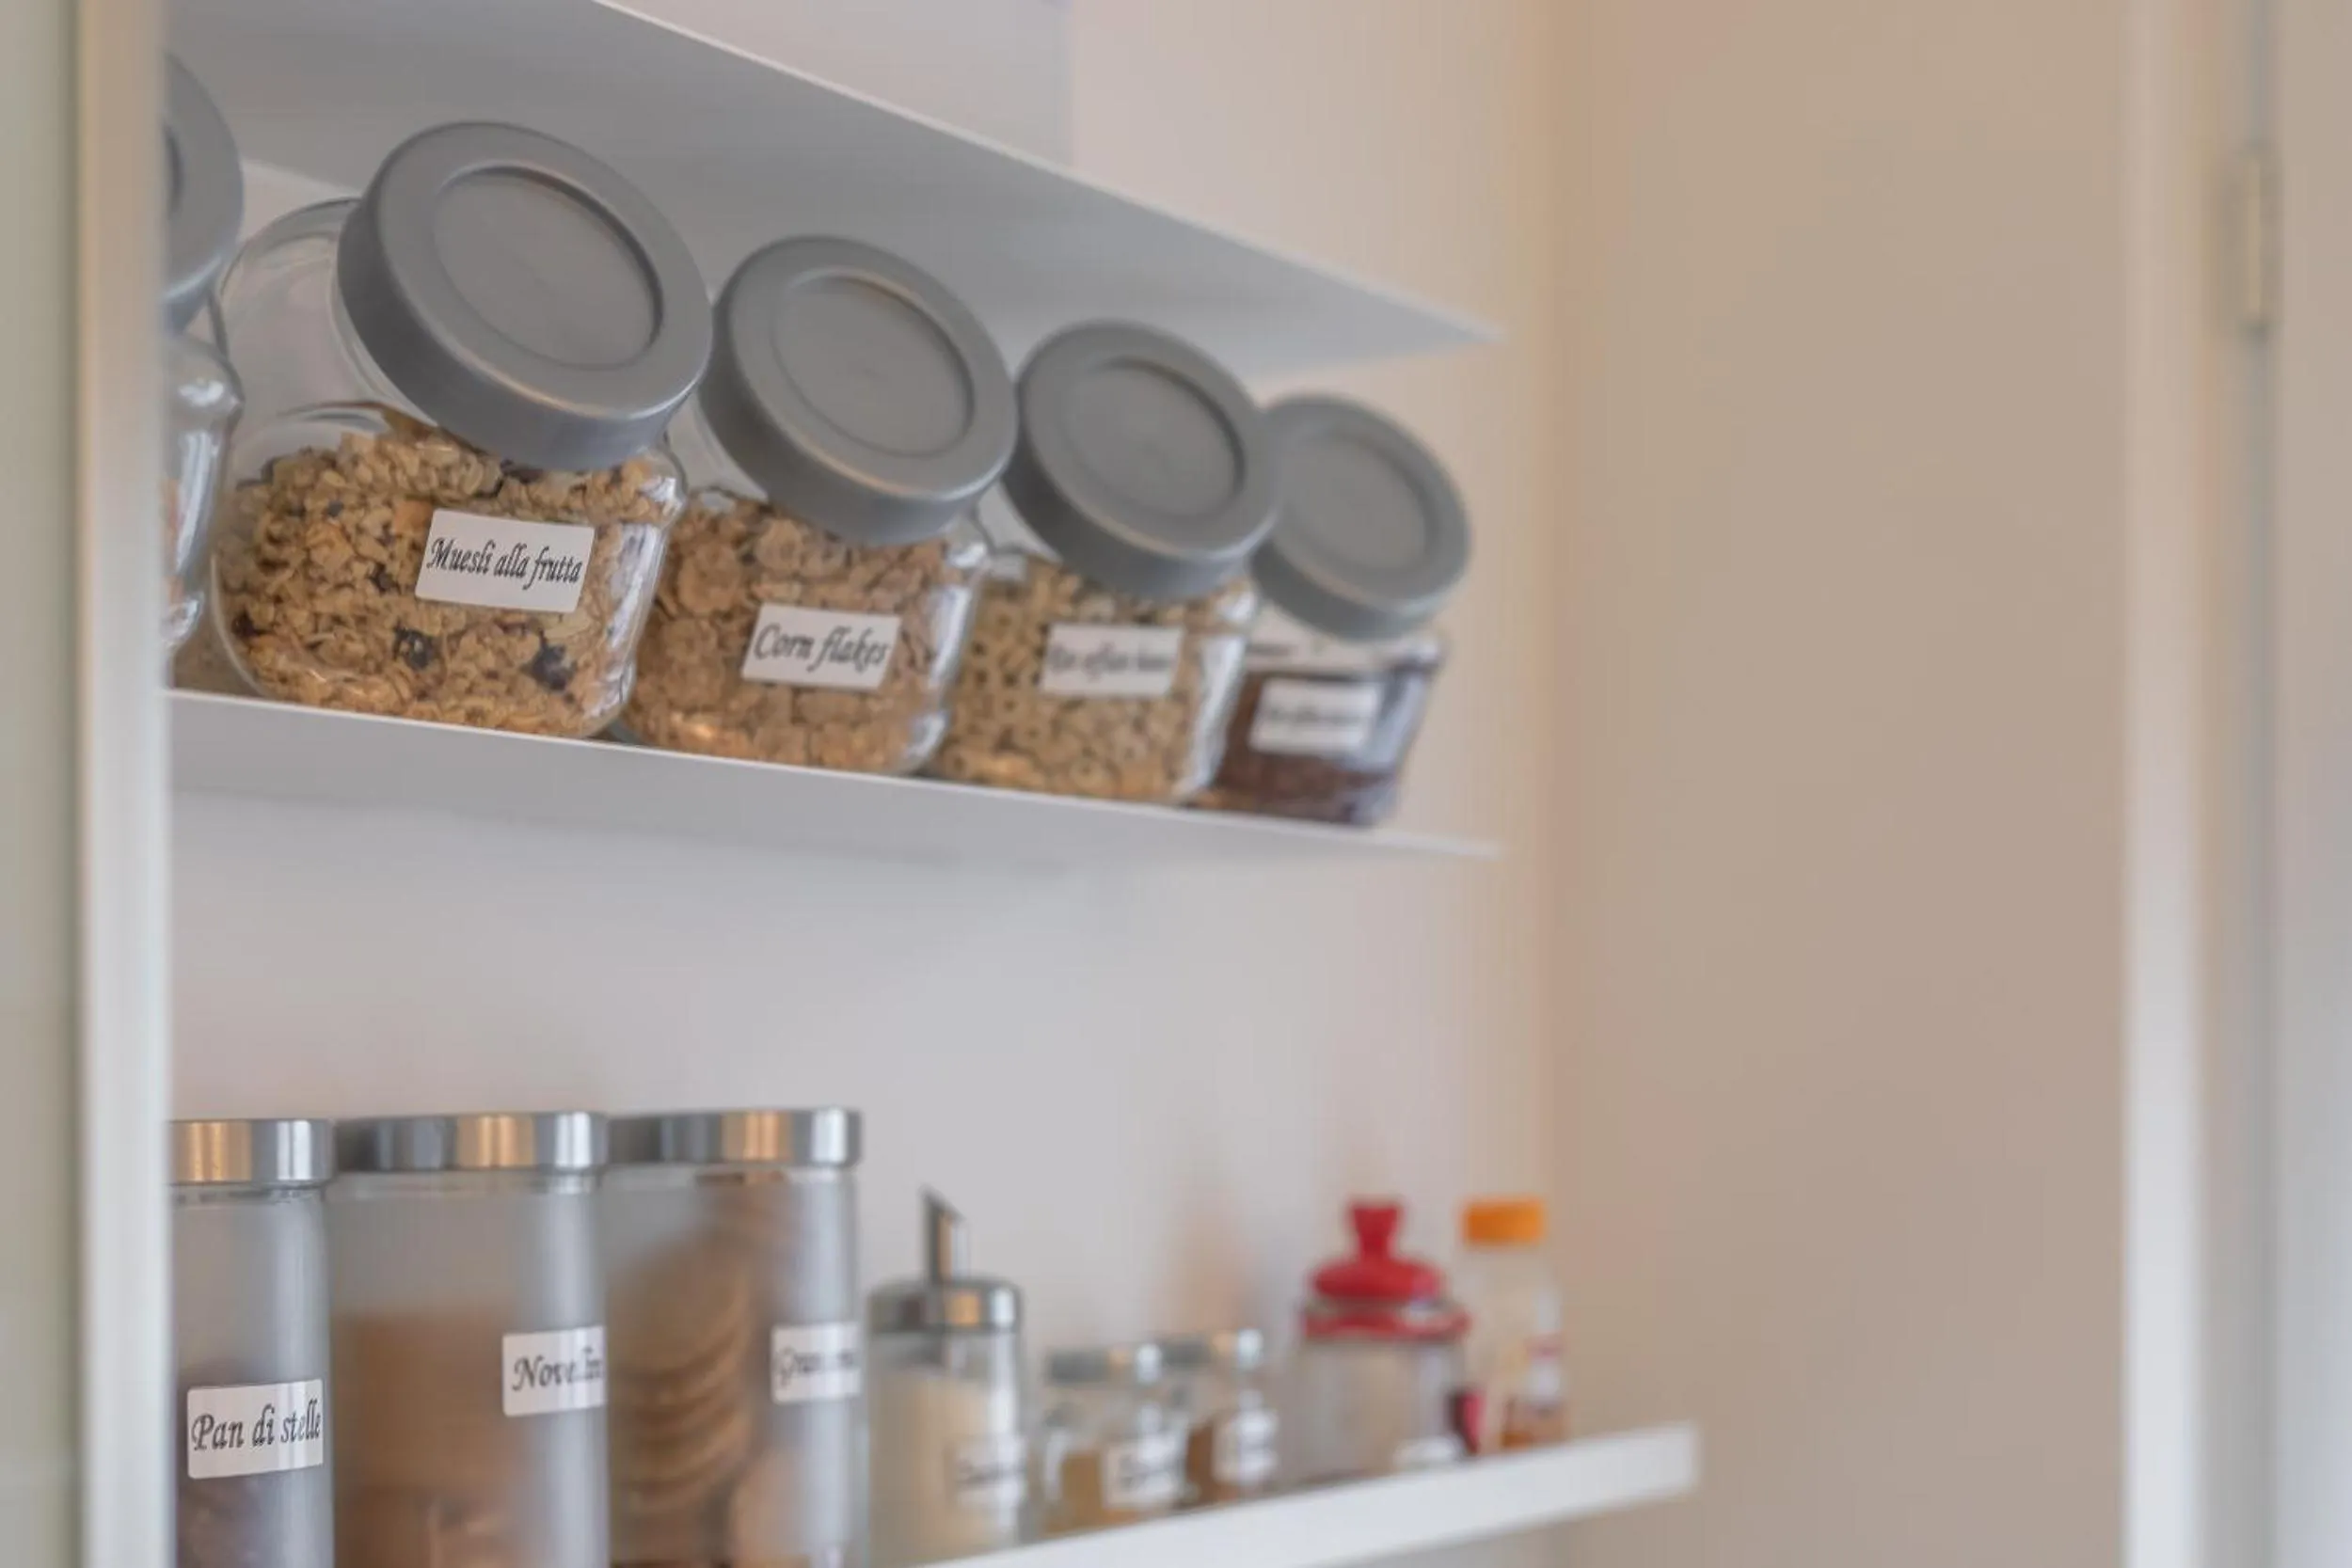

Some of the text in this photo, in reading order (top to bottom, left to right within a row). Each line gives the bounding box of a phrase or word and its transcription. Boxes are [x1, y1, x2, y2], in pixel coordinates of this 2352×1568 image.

[426, 536, 583, 591] Muesli alla frutta
[754, 622, 890, 673] Corn flakes
[191, 1398, 321, 1451] Pan di stelle
